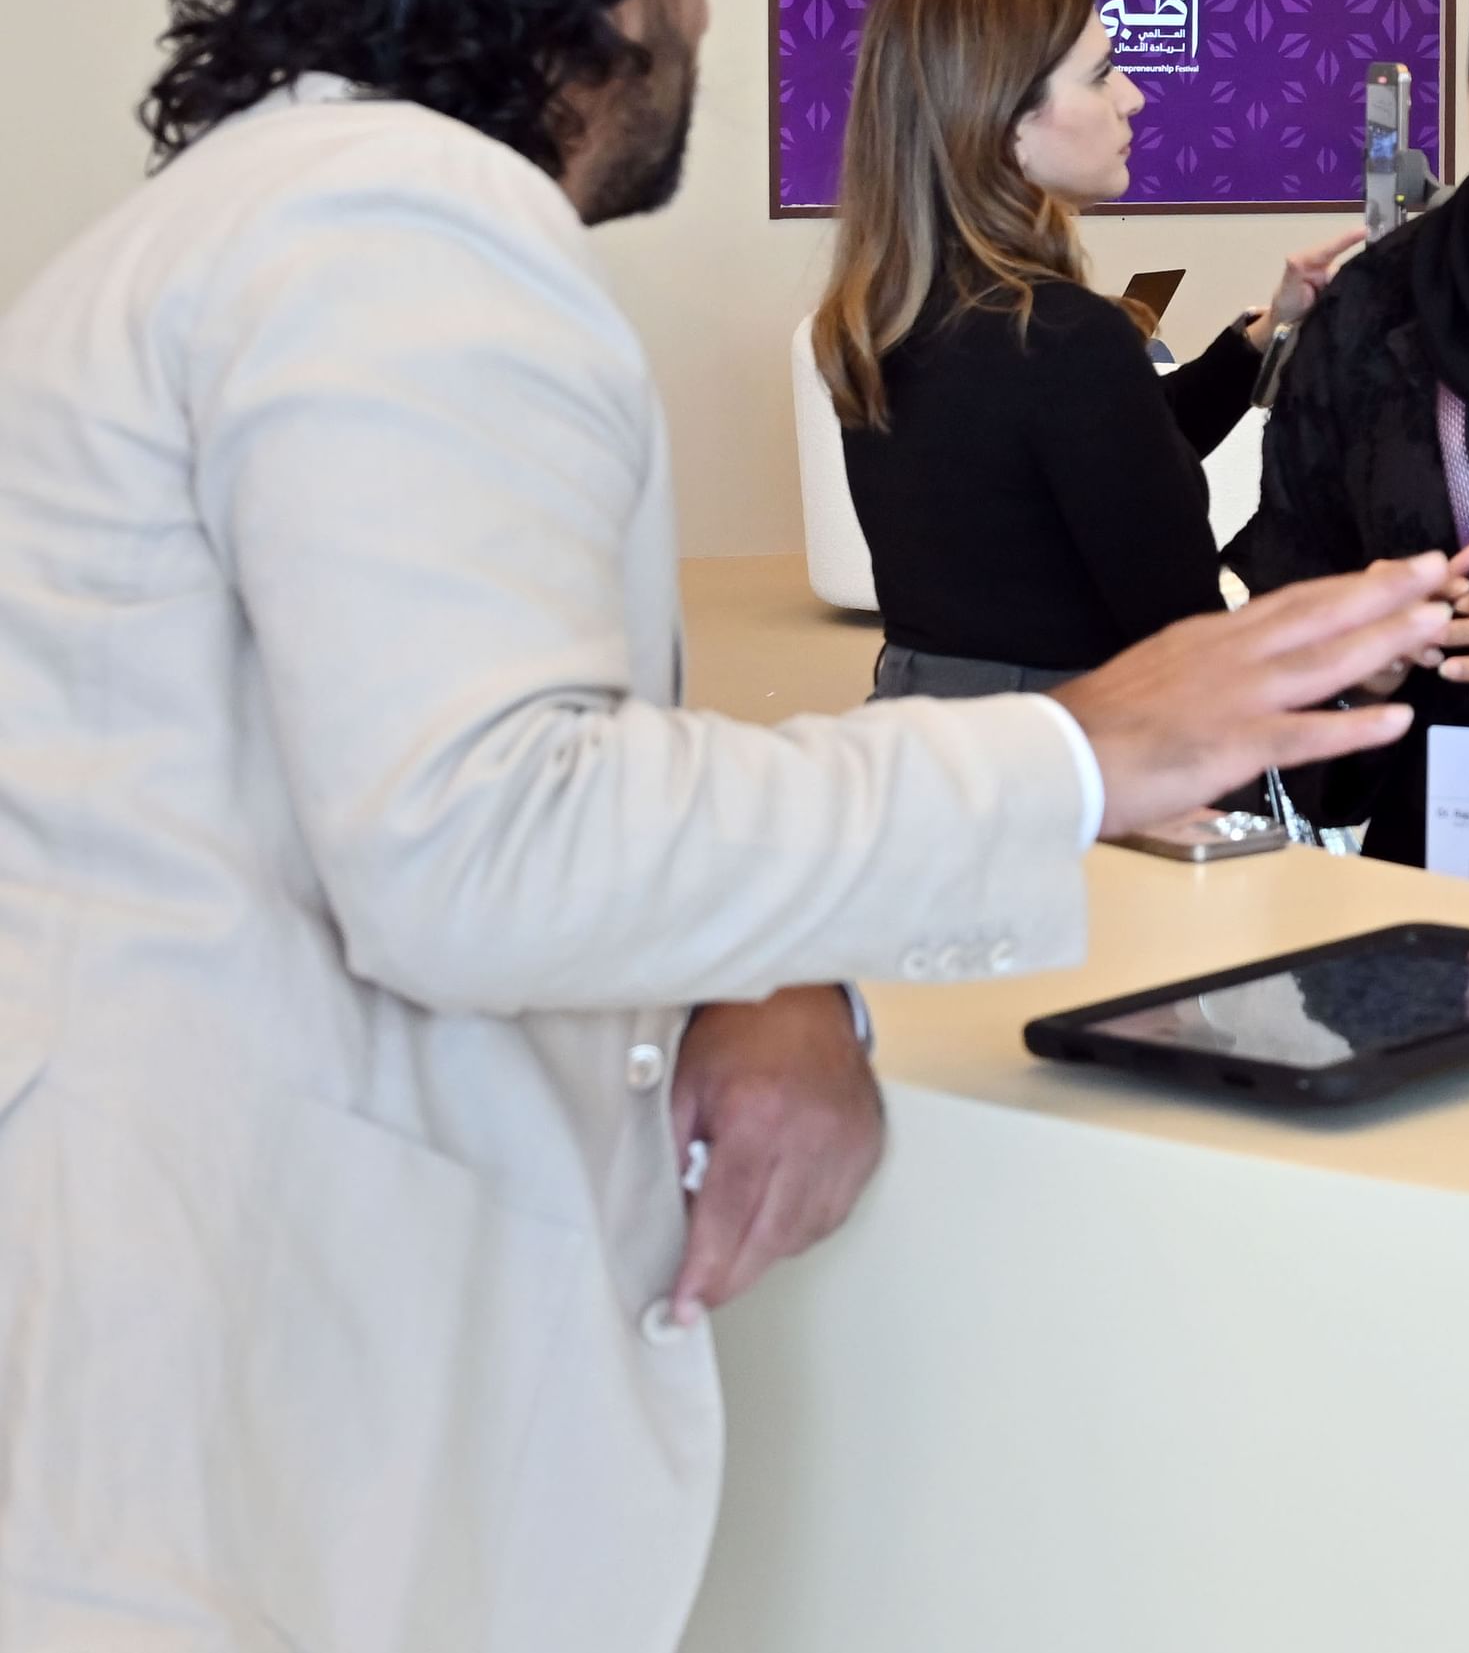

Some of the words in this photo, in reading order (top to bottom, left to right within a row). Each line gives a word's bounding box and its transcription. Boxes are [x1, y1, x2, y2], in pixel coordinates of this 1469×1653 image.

[1138, 28, 1186, 42] العالمي
[1112, 64, 1175, 74] ntrepreneurship
[1175, 64, 1199, 73] Festival
